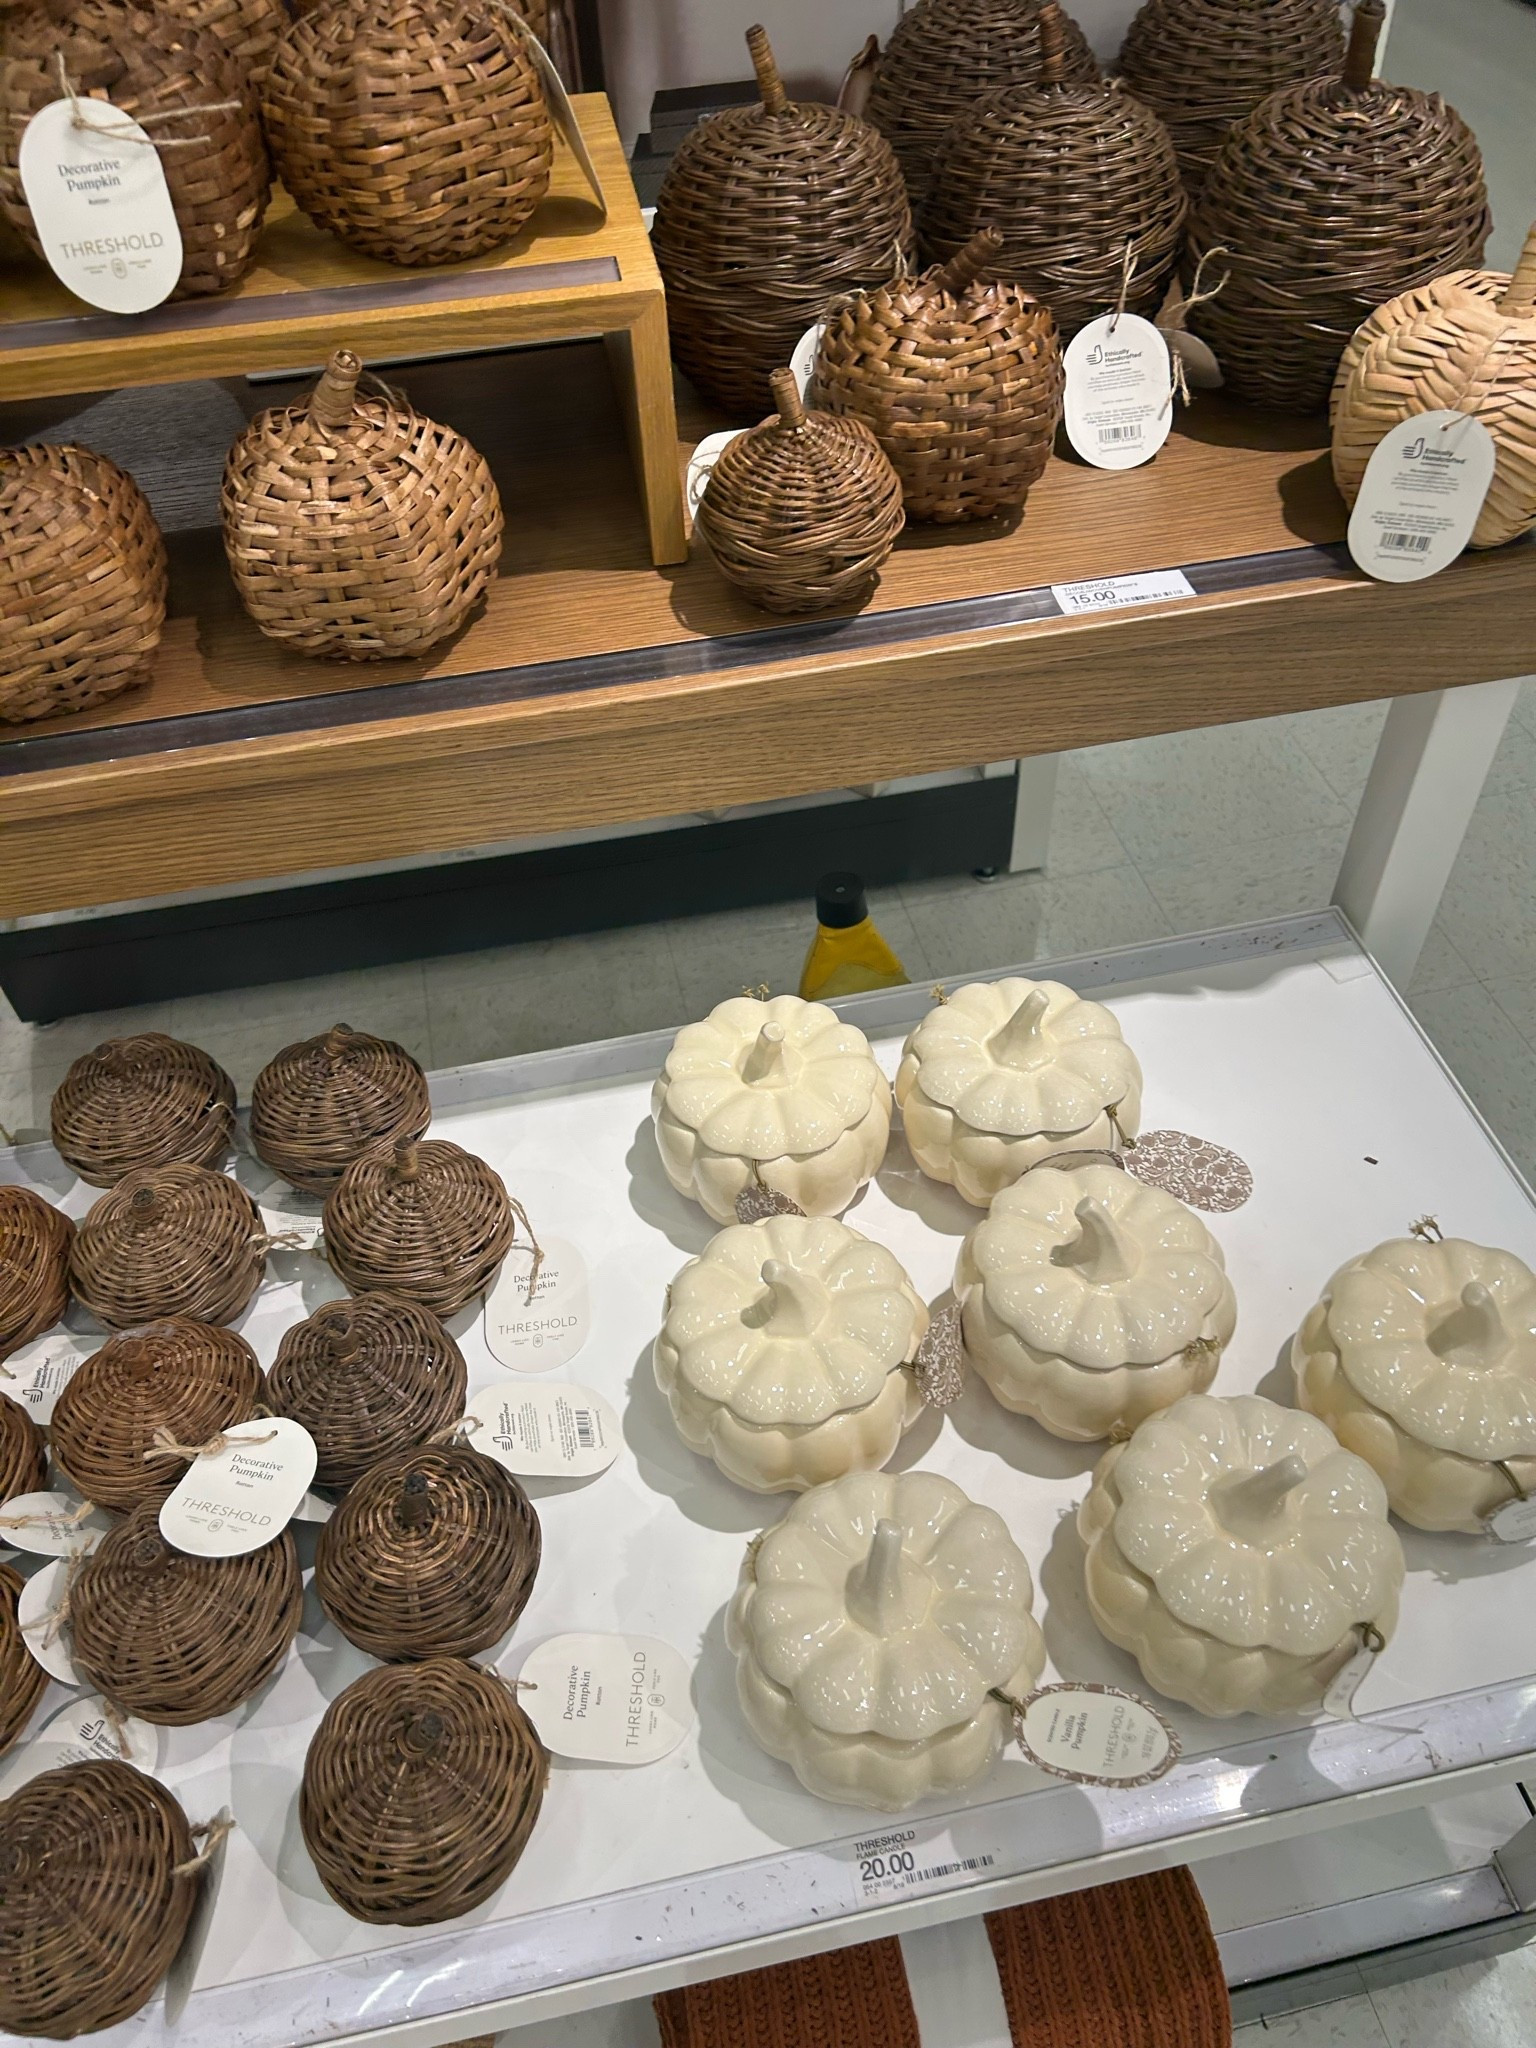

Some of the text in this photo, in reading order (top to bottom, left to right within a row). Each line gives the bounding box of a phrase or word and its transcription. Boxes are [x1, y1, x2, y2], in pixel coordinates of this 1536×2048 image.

[58, 159, 120, 177] Decorative
[66, 175, 121, 192] Pumpkin
[60, 232, 163, 258] THRESHOLD
[1104, 352, 1142, 363] Handcrafted
[1105, 348, 1130, 358] Ethically
[1063, 580, 1116, 592] THRESHOLD
[1070, 590, 1116, 605] 15.00
[513, 1270, 560, 1283] Decoative
[517, 1281, 557, 1293] Pupkin
[498, 1316, 578, 1335] THRESHOLD
[503, 1403, 512, 1435] Handcrafted
[231, 1453, 284, 1472] Decorative
[229, 1464, 274, 1482] Pumpkin
[181, 1497, 272, 1526] THRESHOLD
[563, 1665, 579, 1721] Decorative
[576, 1670, 591, 1718] Pumpkin
[626, 1651, 647, 1747] THRESHOLD
[1060, 1714, 1076, 1743] Vanilla
[1071, 1712, 1088, 1750] Pumpkin
[1103, 1705, 1126, 1767] THRESHOLD
[854, 1830, 916, 1852] THRESHOLD
[856, 1843, 906, 1860] FLAME CANDLE
[860, 1851, 915, 1881] 20.00
